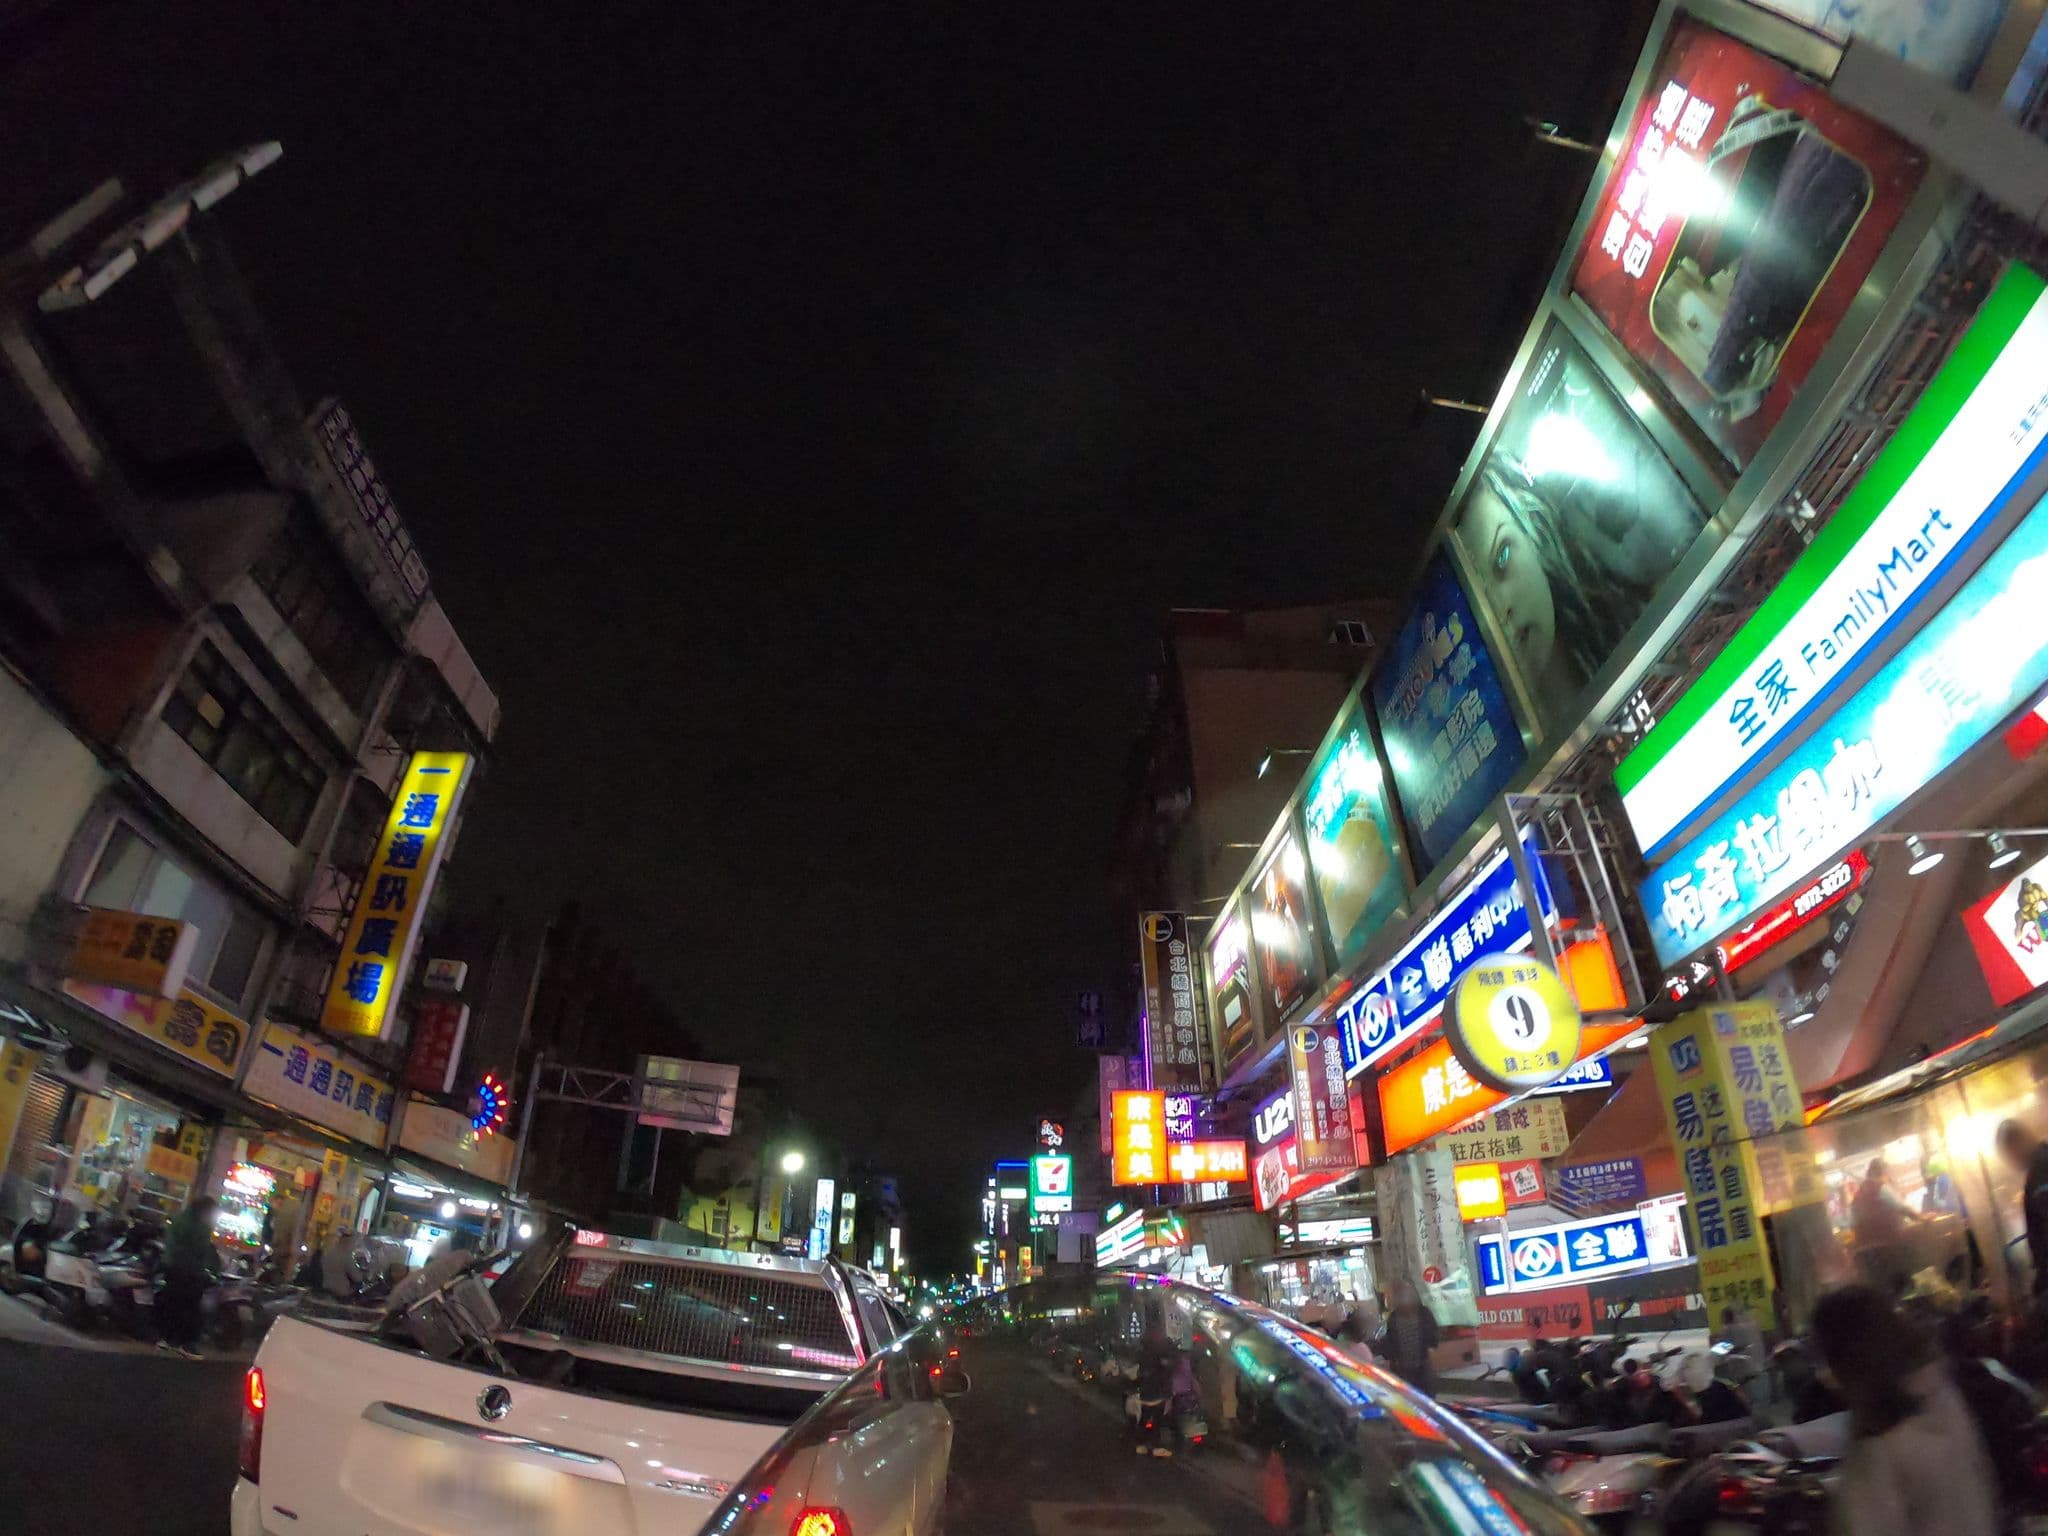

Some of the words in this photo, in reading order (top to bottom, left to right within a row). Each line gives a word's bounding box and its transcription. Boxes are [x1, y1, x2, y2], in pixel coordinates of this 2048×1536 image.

[1729, 659, 1798, 748] 全家
[1801, 507, 1953, 676] FamilyMart
[342, 767, 452, 1005] 一通通訊廣場
[164, 999, 242, 1067] 壽司
[1168, 938, 1197, 1066] 台北橋商務中心
[1505, 994, 1535, 1039] 9
[1322, 1034, 1352, 1140] 台北橋商務中心
[1420, 1054, 1483, 1117] 康是
[1127, 1095, 1154, 1179] 康是美
[1208, 1150, 1244, 1172] 24H
[1449, 1135, 1524, 1162] 駐店指導
[1572, 1222, 1639, 1267] 全聯
[1500, 1308, 1525, 1323] GYM
